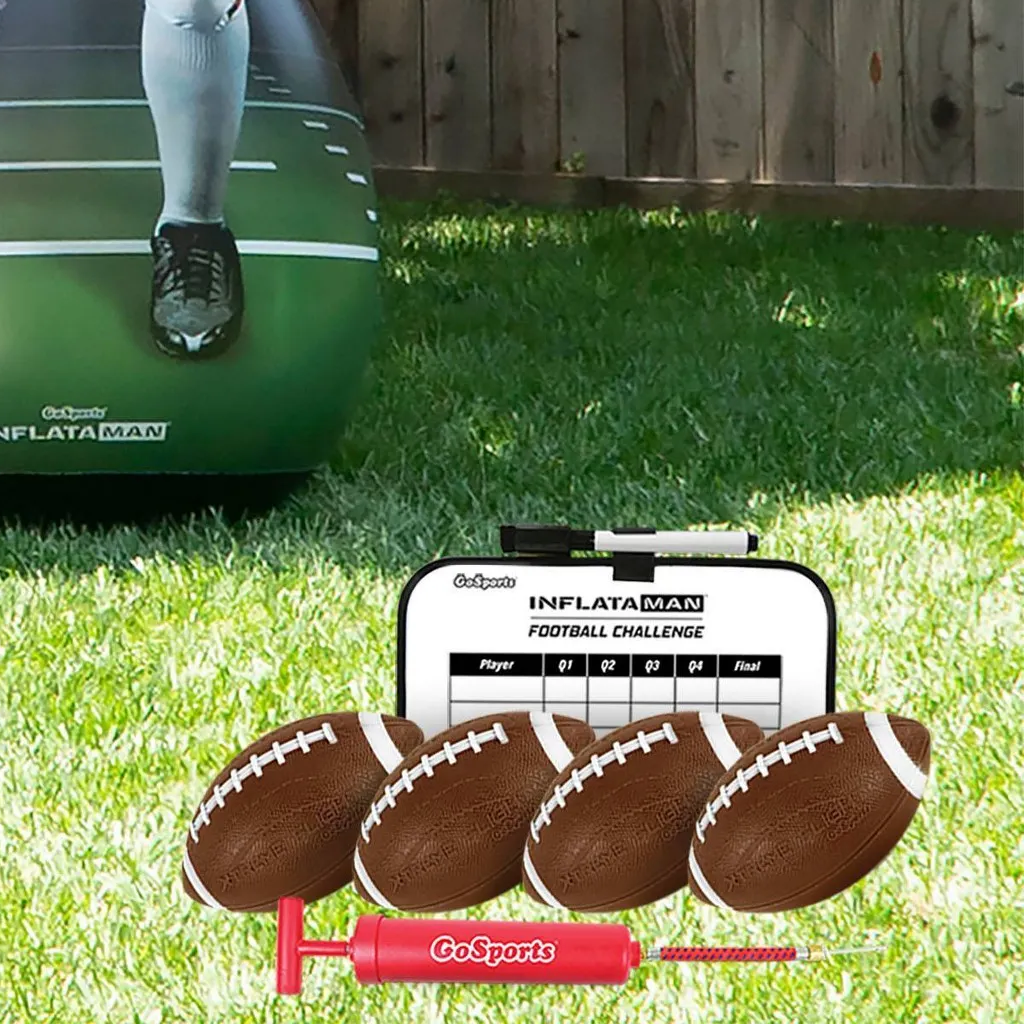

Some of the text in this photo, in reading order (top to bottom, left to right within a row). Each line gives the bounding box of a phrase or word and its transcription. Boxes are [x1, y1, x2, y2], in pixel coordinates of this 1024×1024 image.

[453, 573, 517, 590] GoSports
[528, 594, 705, 613] INFLATAMAN
[527, 624, 706, 640] FOOTBALL CHALLENGE
[478, 658, 516, 672] Player
[557, 659, 574, 674] Q1
[600, 659, 617, 674] Q2
[644, 659, 661, 674] Q3
[688, 659, 704, 674] Q4
[733, 660, 762, 673] Final
[429, 934, 557, 967] GoSports
